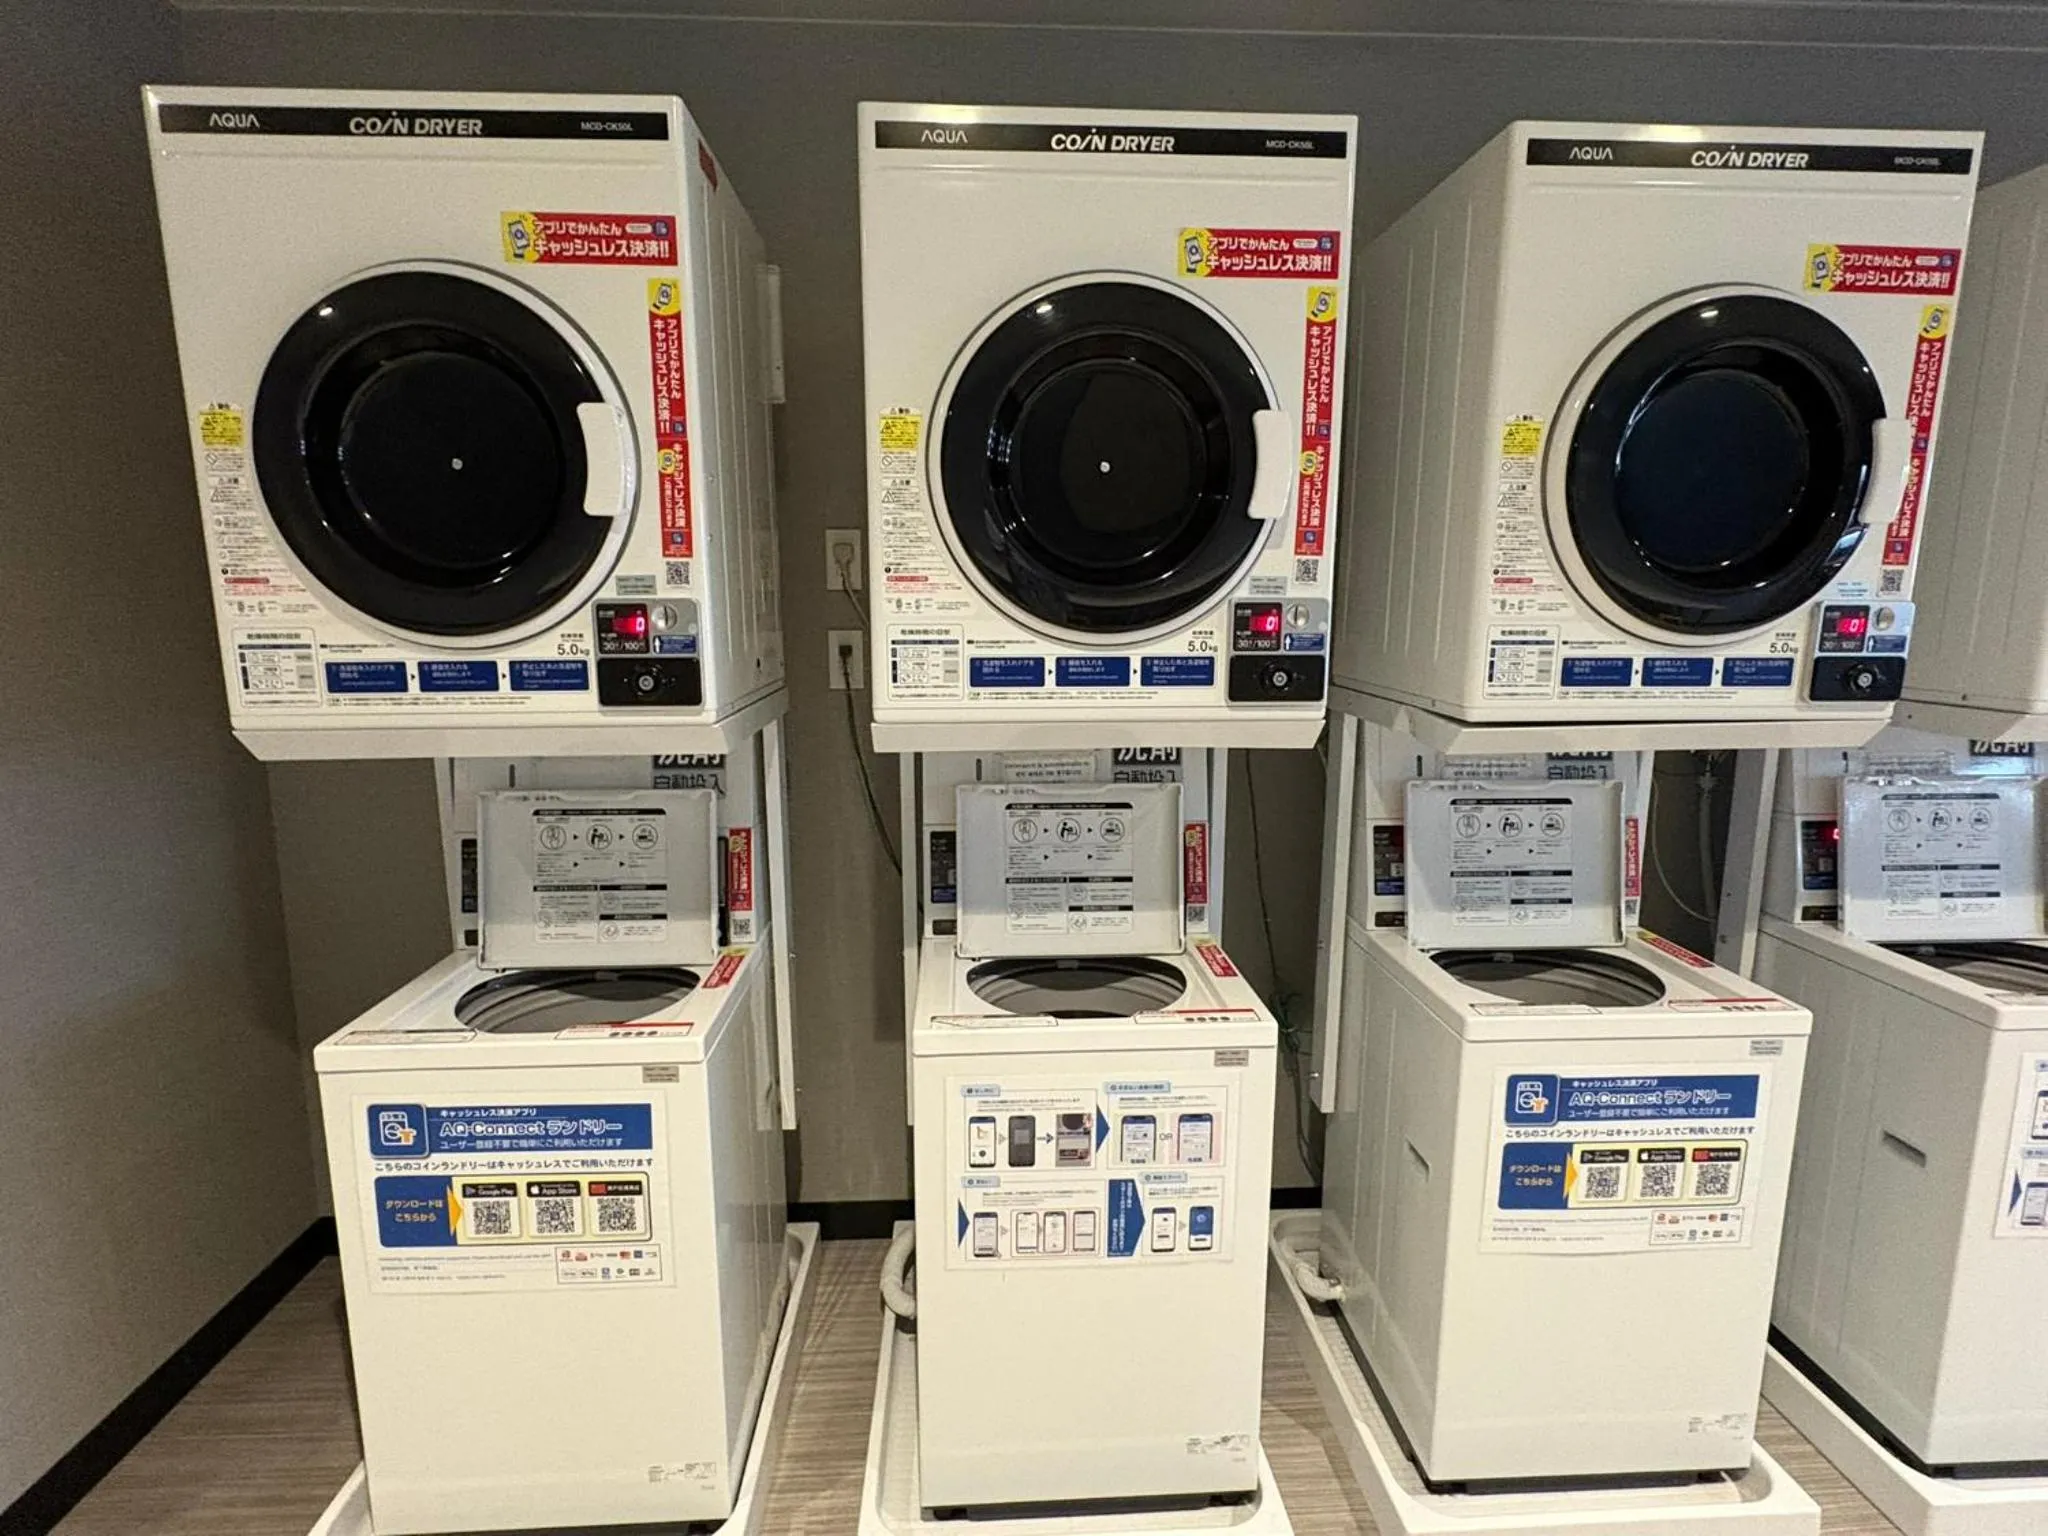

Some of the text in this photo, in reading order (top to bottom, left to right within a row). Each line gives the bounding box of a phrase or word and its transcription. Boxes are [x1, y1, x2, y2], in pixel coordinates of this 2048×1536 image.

[209, 112, 260, 128] AQUA
[414, 118, 483, 135] DRYER
[921, 130, 968, 144] AQUA
[1111, 135, 1174, 153] DRYER
[1568, 147, 1613, 161] AQUA
[1747, 152, 1809, 168] DRYER
[534, 219, 622, 237] アプリでかんたん
[1206, 236, 1289, 252] アプリでかんたん
[1835, 252, 1912, 268] アプリでかんたん
[549, 1119, 623, 1134] ランドリー
[374, 1157, 654, 1172] こちらのコインランドリーはキャッシュレスでご利用いただけます
[385, 1200, 443, 1209] ダウンロードは
[394, 1212, 437, 1222] こちらから
